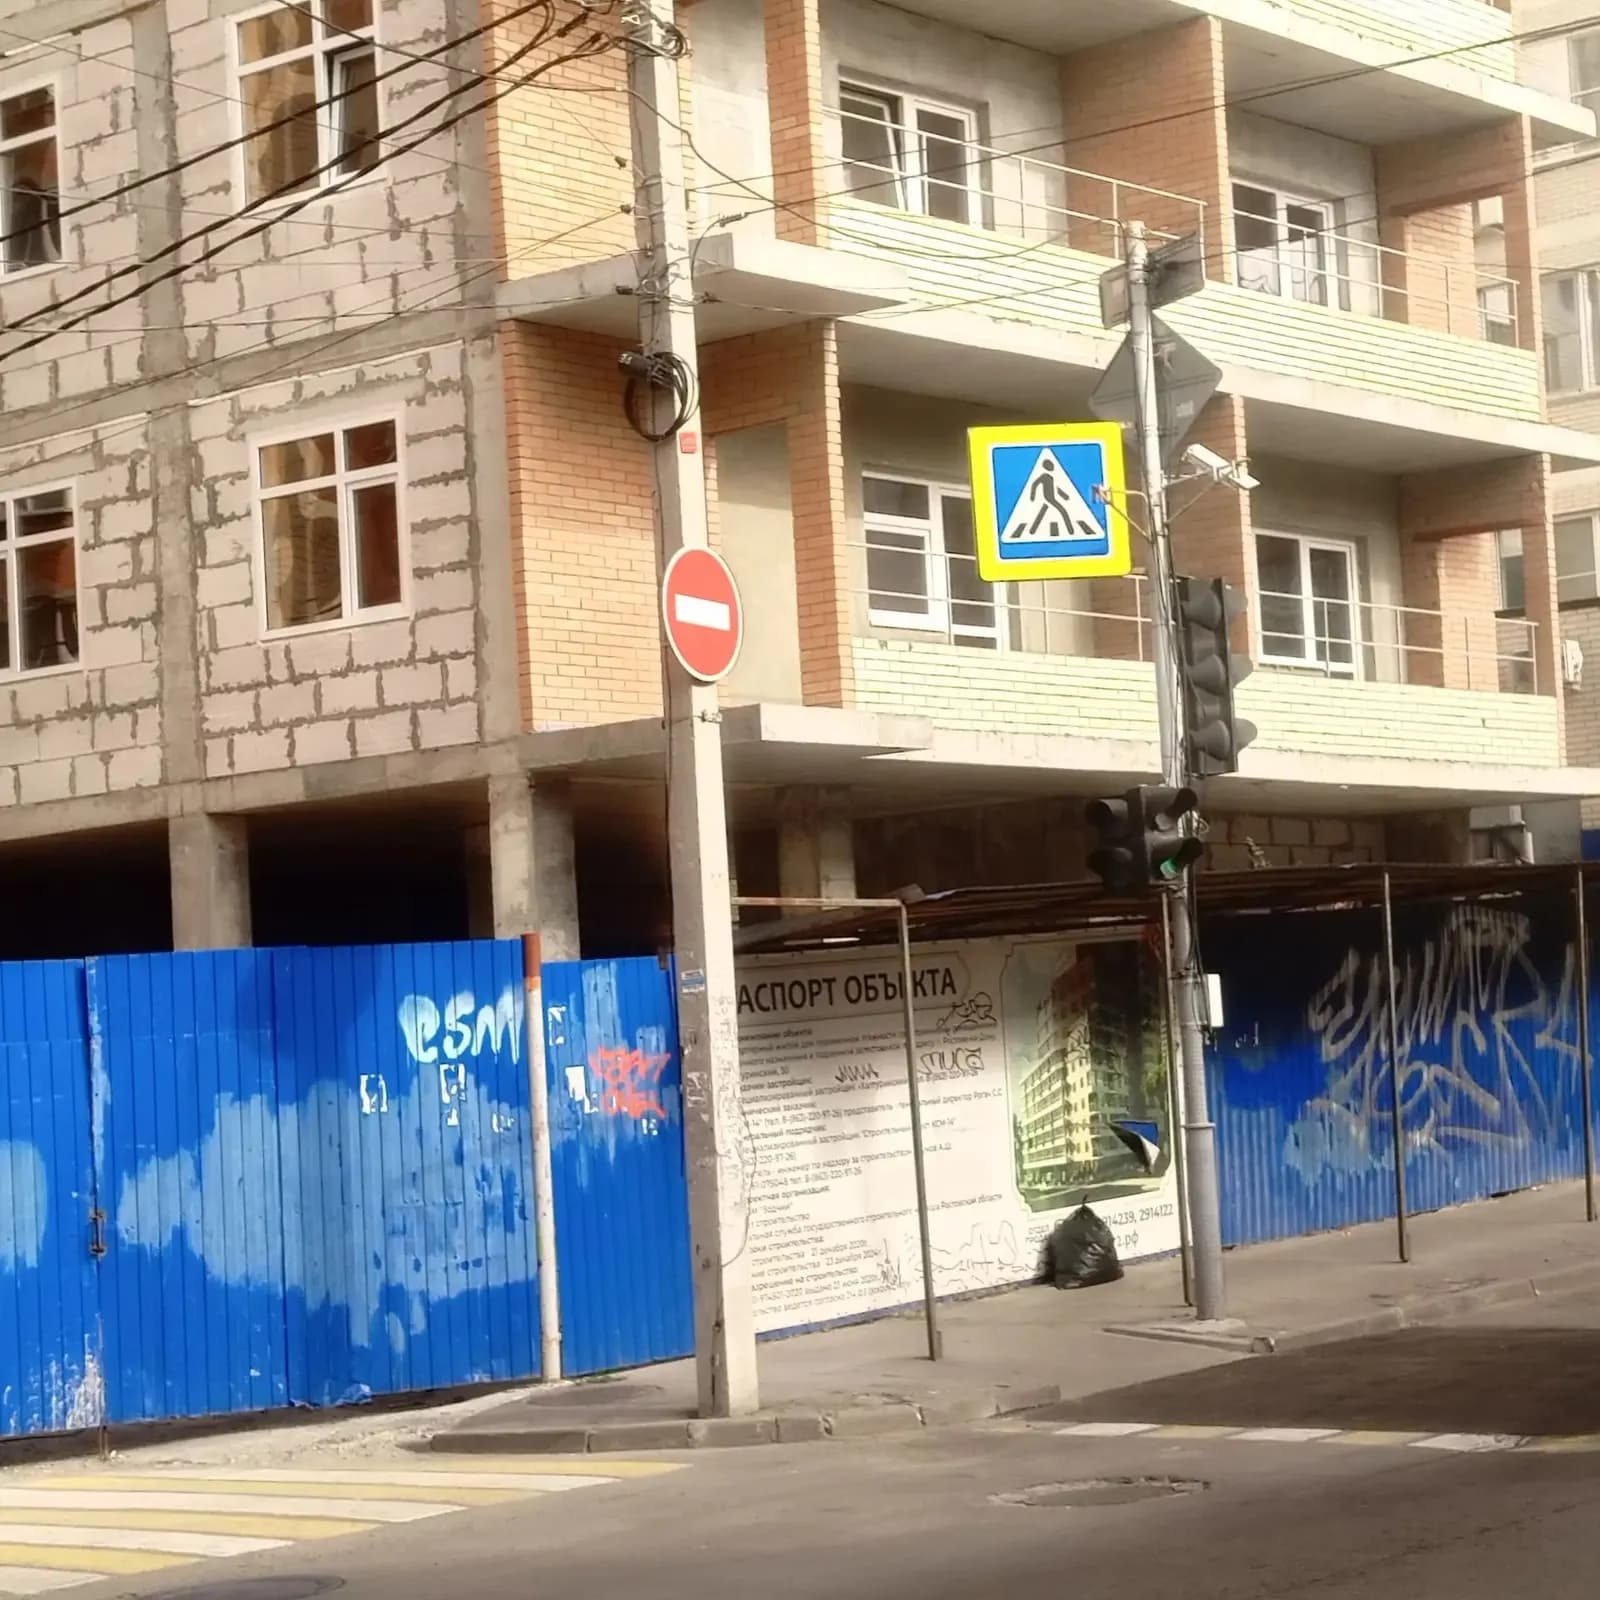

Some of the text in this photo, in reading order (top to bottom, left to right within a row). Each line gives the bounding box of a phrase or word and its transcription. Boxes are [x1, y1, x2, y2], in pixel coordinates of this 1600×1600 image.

[737, 976, 837, 1015] АСПОРТ
[1104, 1203, 1174, 1227] 914239, 2914122
